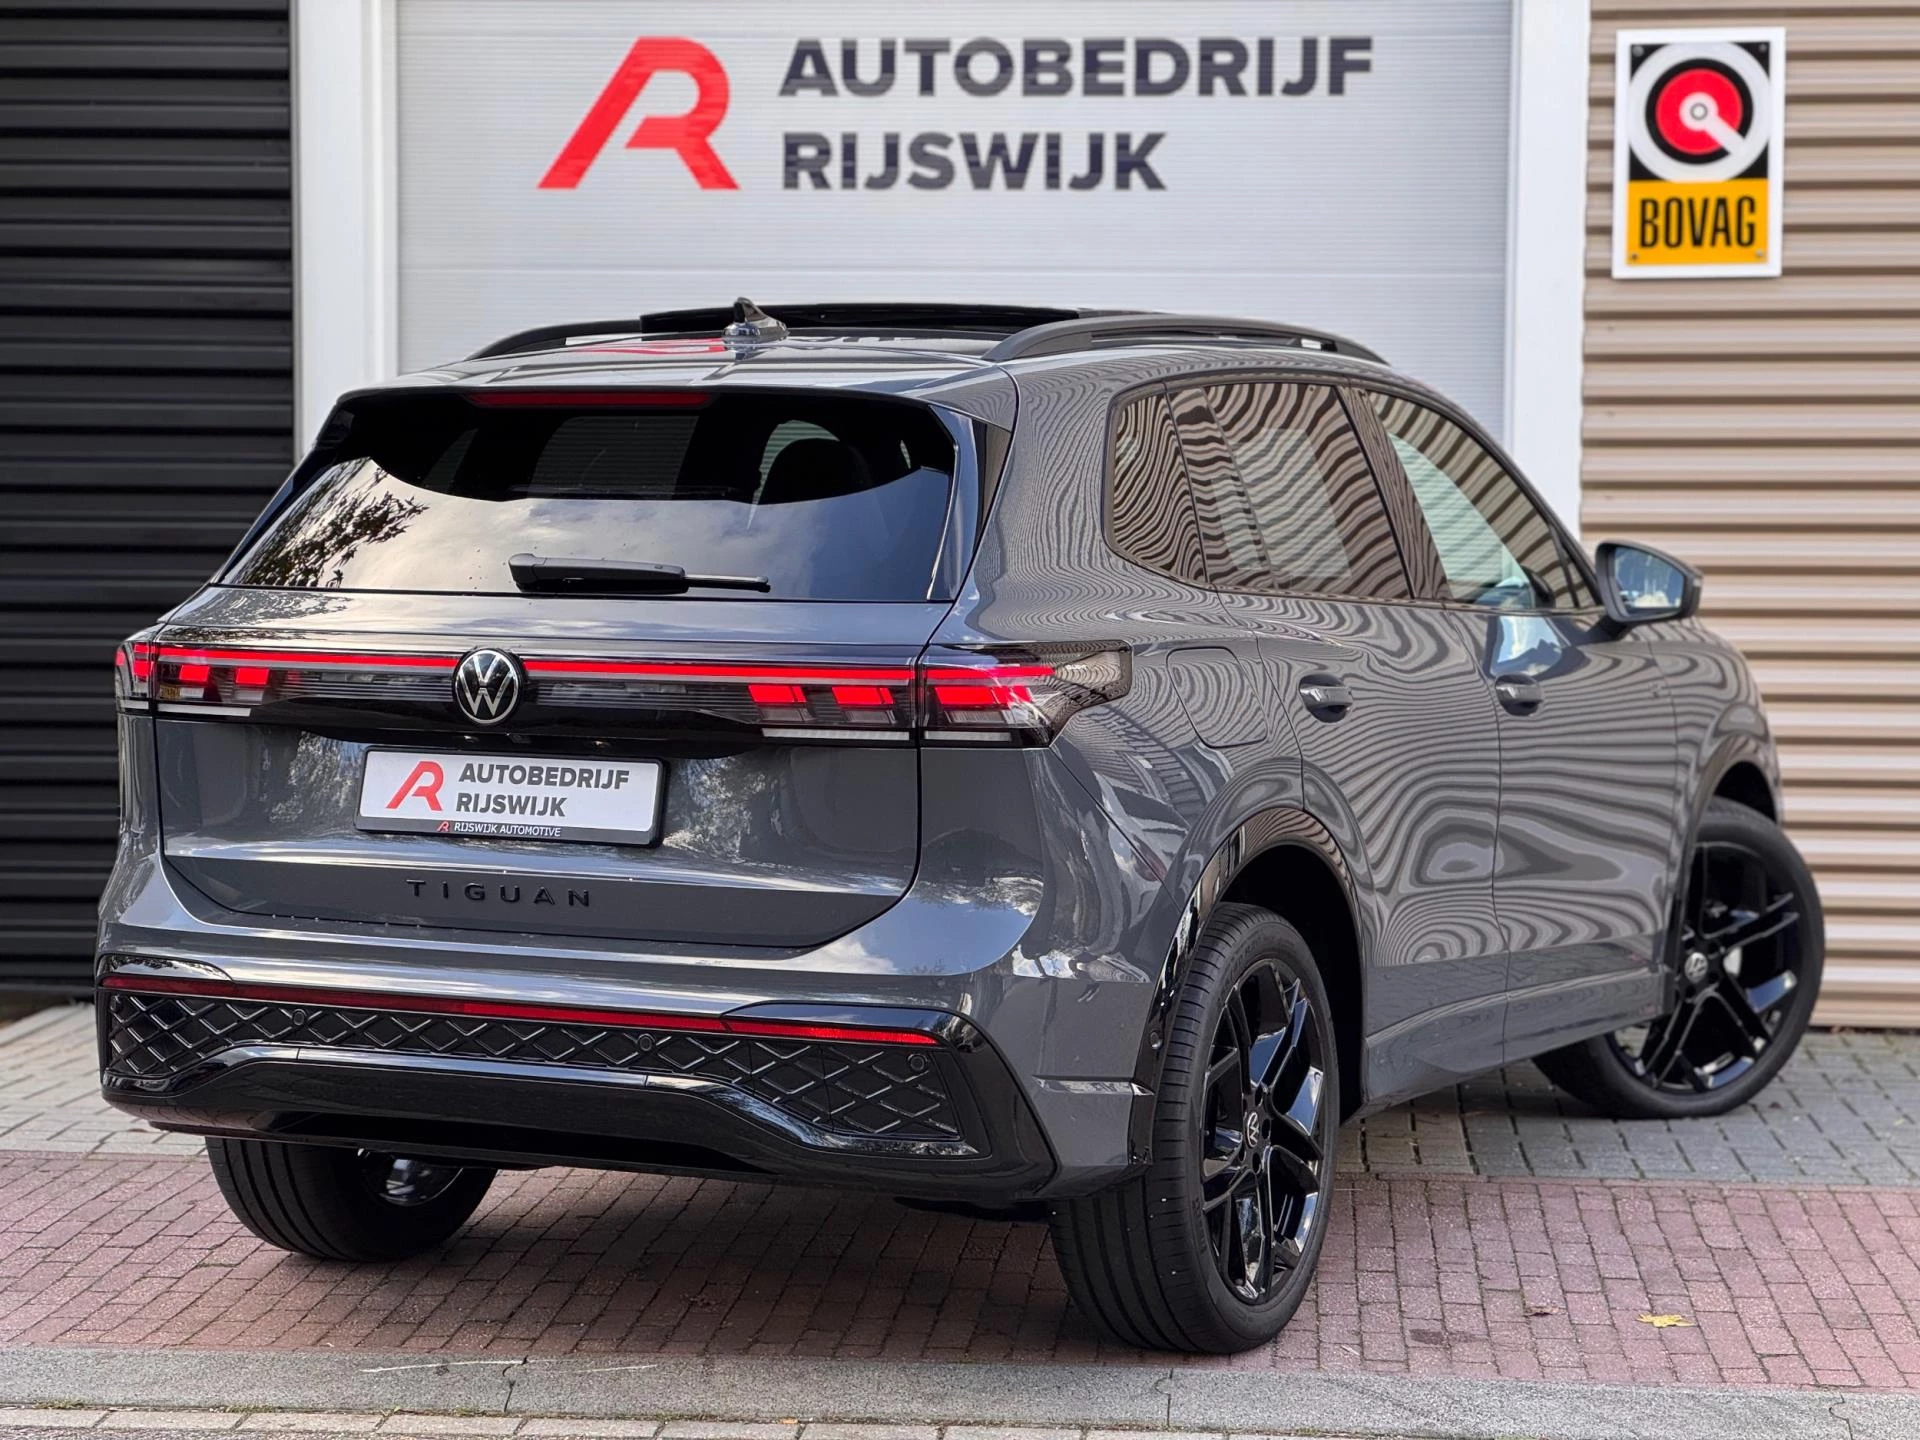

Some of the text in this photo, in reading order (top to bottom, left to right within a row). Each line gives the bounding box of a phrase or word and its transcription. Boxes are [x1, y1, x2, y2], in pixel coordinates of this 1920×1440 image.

[779, 37, 1373, 97] AUTOBEDRIJF
[783, 132, 1166, 191] RIJSWIJK
[1639, 195, 1756, 249] BOVAG
[458, 762, 630, 790] AUTOBEDRIJF
[456, 792, 567, 817] RIJSWIJK
[454, 822, 498, 833] RIJSWIJK
[499, 824, 561, 837] AUTOMOTIVE
[406, 879, 590, 907] TIGUAN
